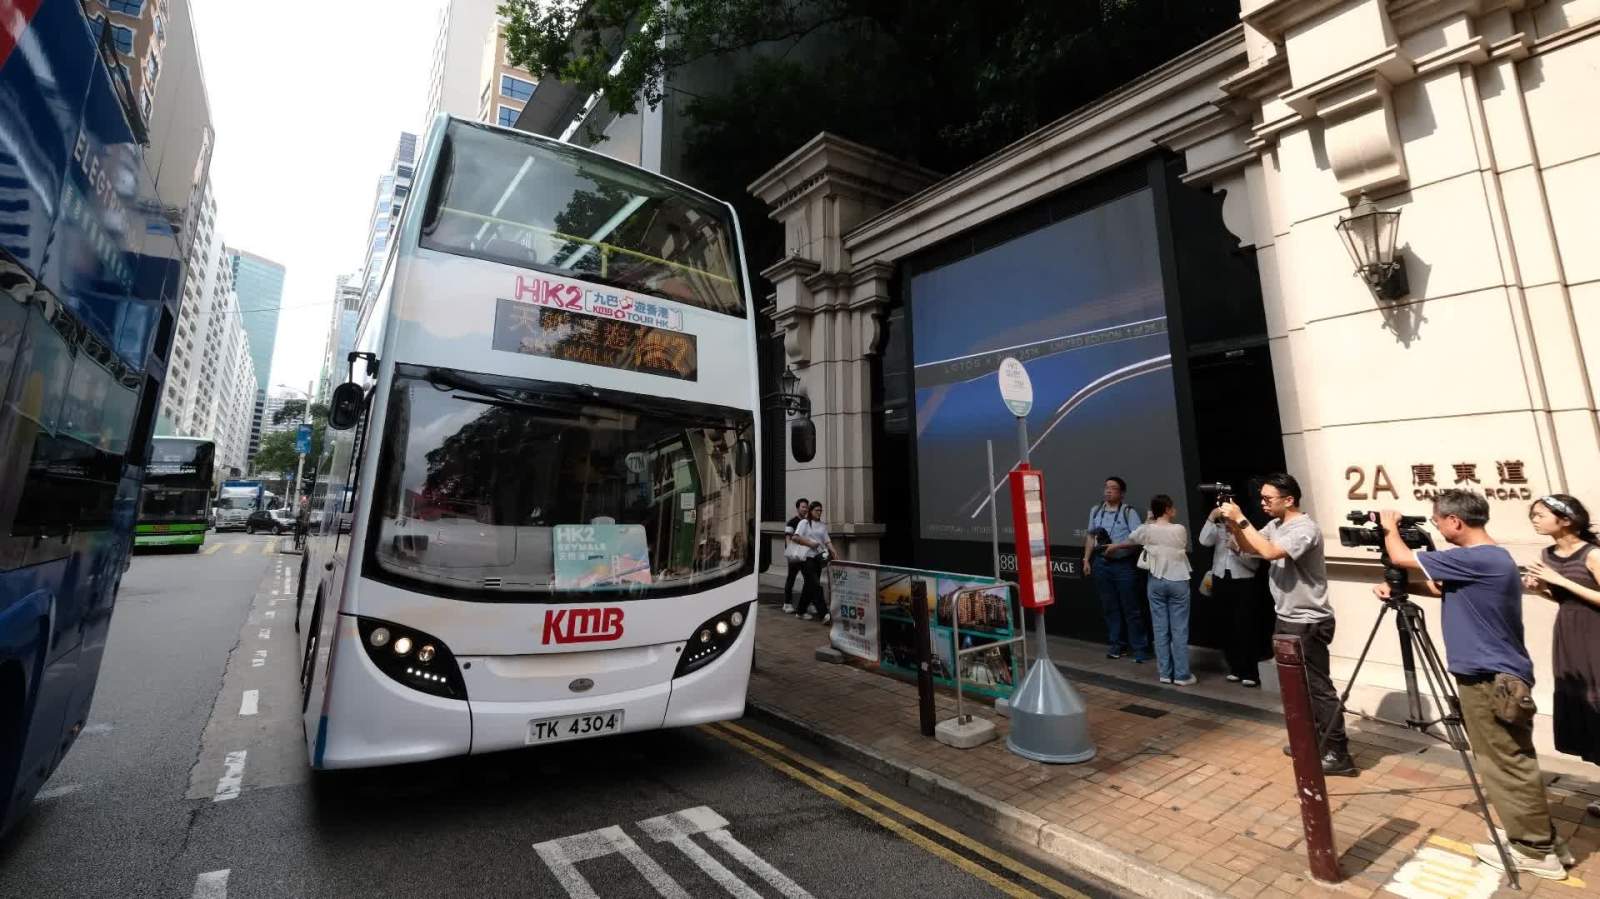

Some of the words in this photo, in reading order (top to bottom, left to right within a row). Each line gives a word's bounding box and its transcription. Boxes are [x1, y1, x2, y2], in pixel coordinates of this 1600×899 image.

[515, 275, 583, 311] HK2
[594, 292, 618, 307] 九巴
[592, 305, 614, 317] KMB
[626, 311, 654, 325] TOUR
[655, 317, 669, 328] HK
[1345, 464, 1399, 500] 2A
[1410, 459, 1529, 487] 廣東道
[1484, 487, 1531, 501] ROAD
[556, 527, 595, 543] HK2
[542, 607, 625, 645] KMB
[535, 720, 560, 739] TK
[568, 713, 616, 735] 4304
